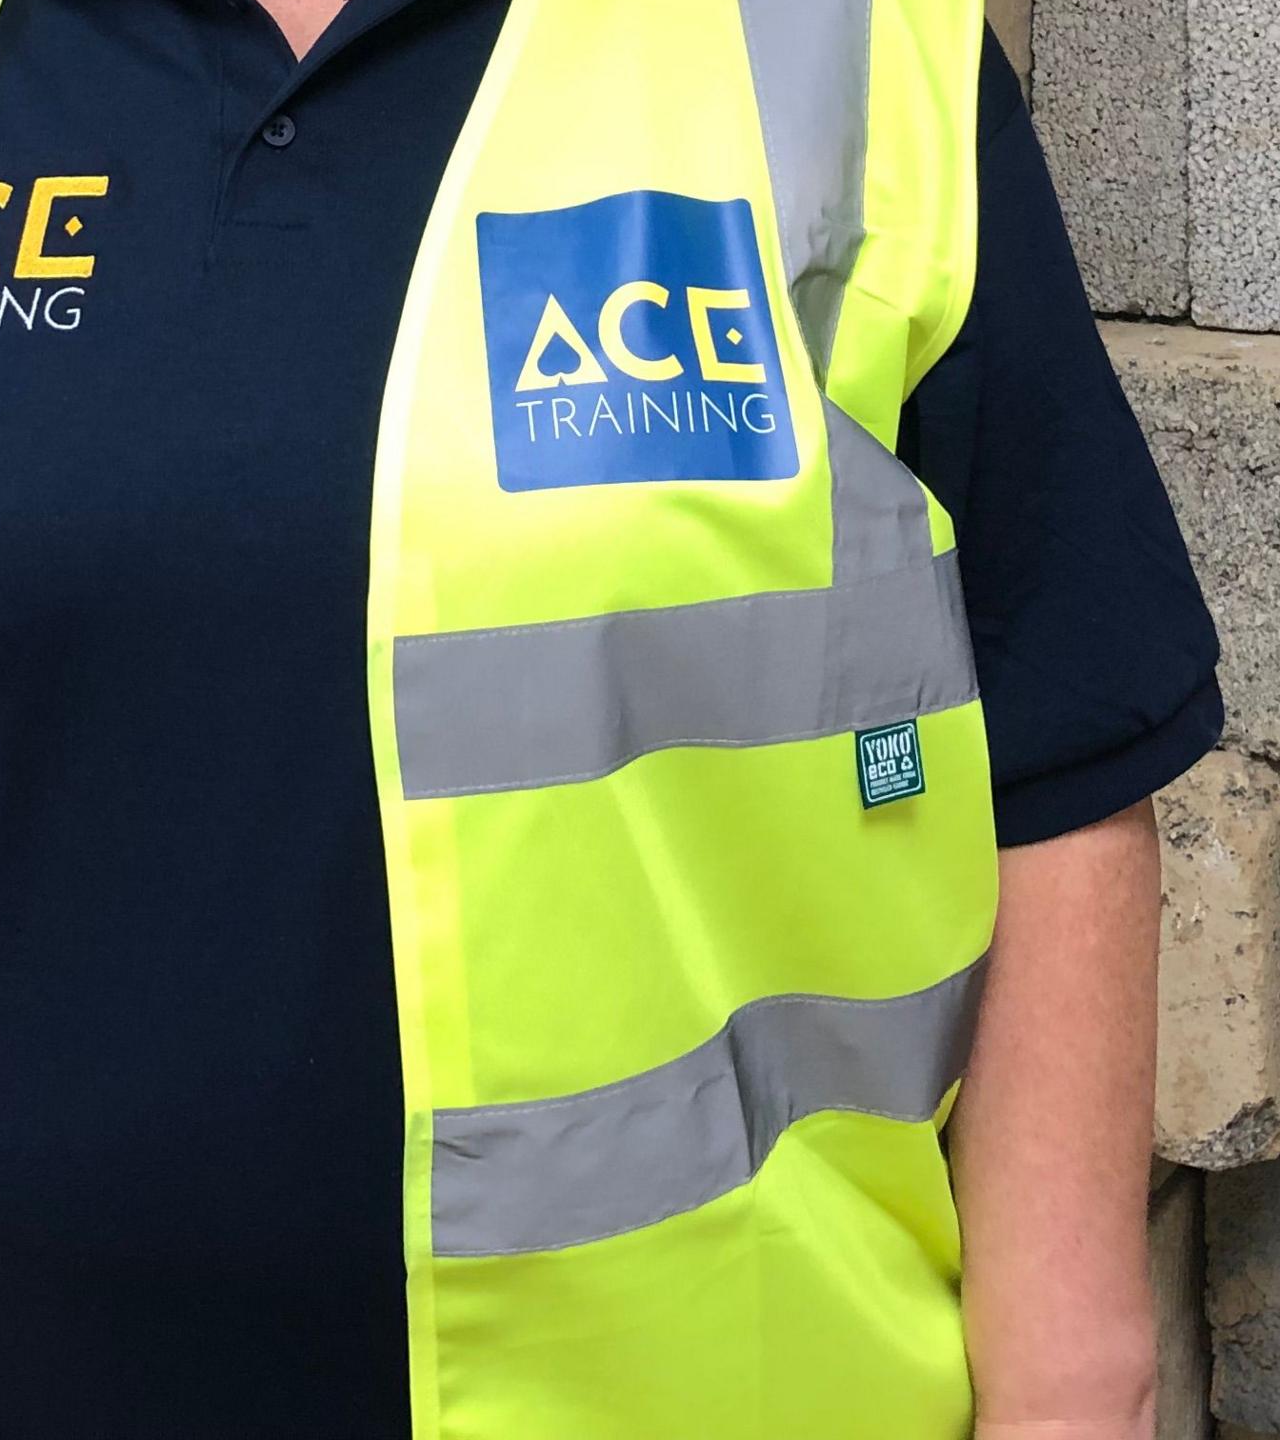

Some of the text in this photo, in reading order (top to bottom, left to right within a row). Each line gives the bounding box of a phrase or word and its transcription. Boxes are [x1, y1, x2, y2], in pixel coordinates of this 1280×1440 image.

[515, 280, 767, 392] ACE
[516, 392, 776, 442] TRAINING
[865, 731, 911, 763] YOKO
